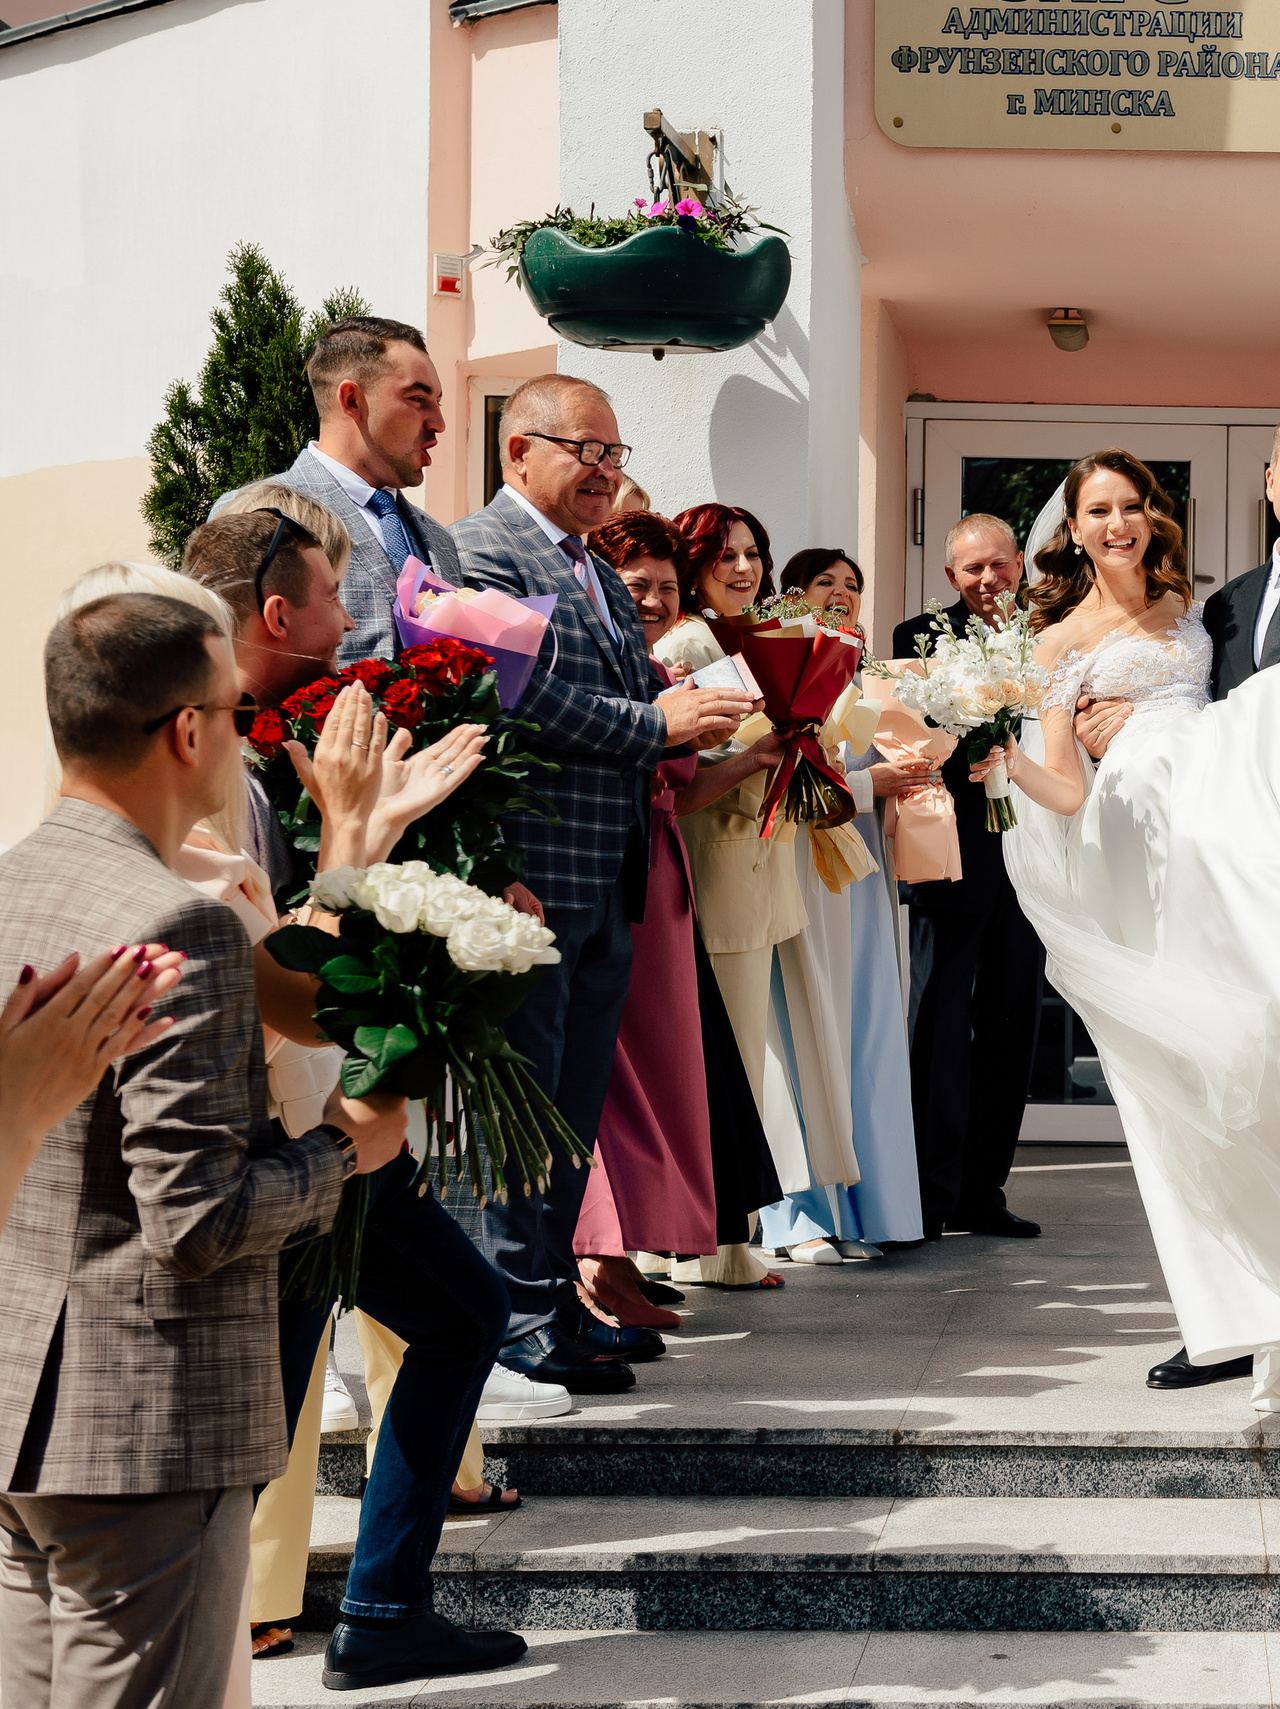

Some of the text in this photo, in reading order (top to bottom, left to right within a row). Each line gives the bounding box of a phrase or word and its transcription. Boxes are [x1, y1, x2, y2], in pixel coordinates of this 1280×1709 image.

[941, 7, 1243, 42] АДМИНИСТРАЦИИ
[891, 46, 1150, 76] ФРУНЗЕНСКОГО
[1006, 89, 1175, 116] г. МИНСКА
